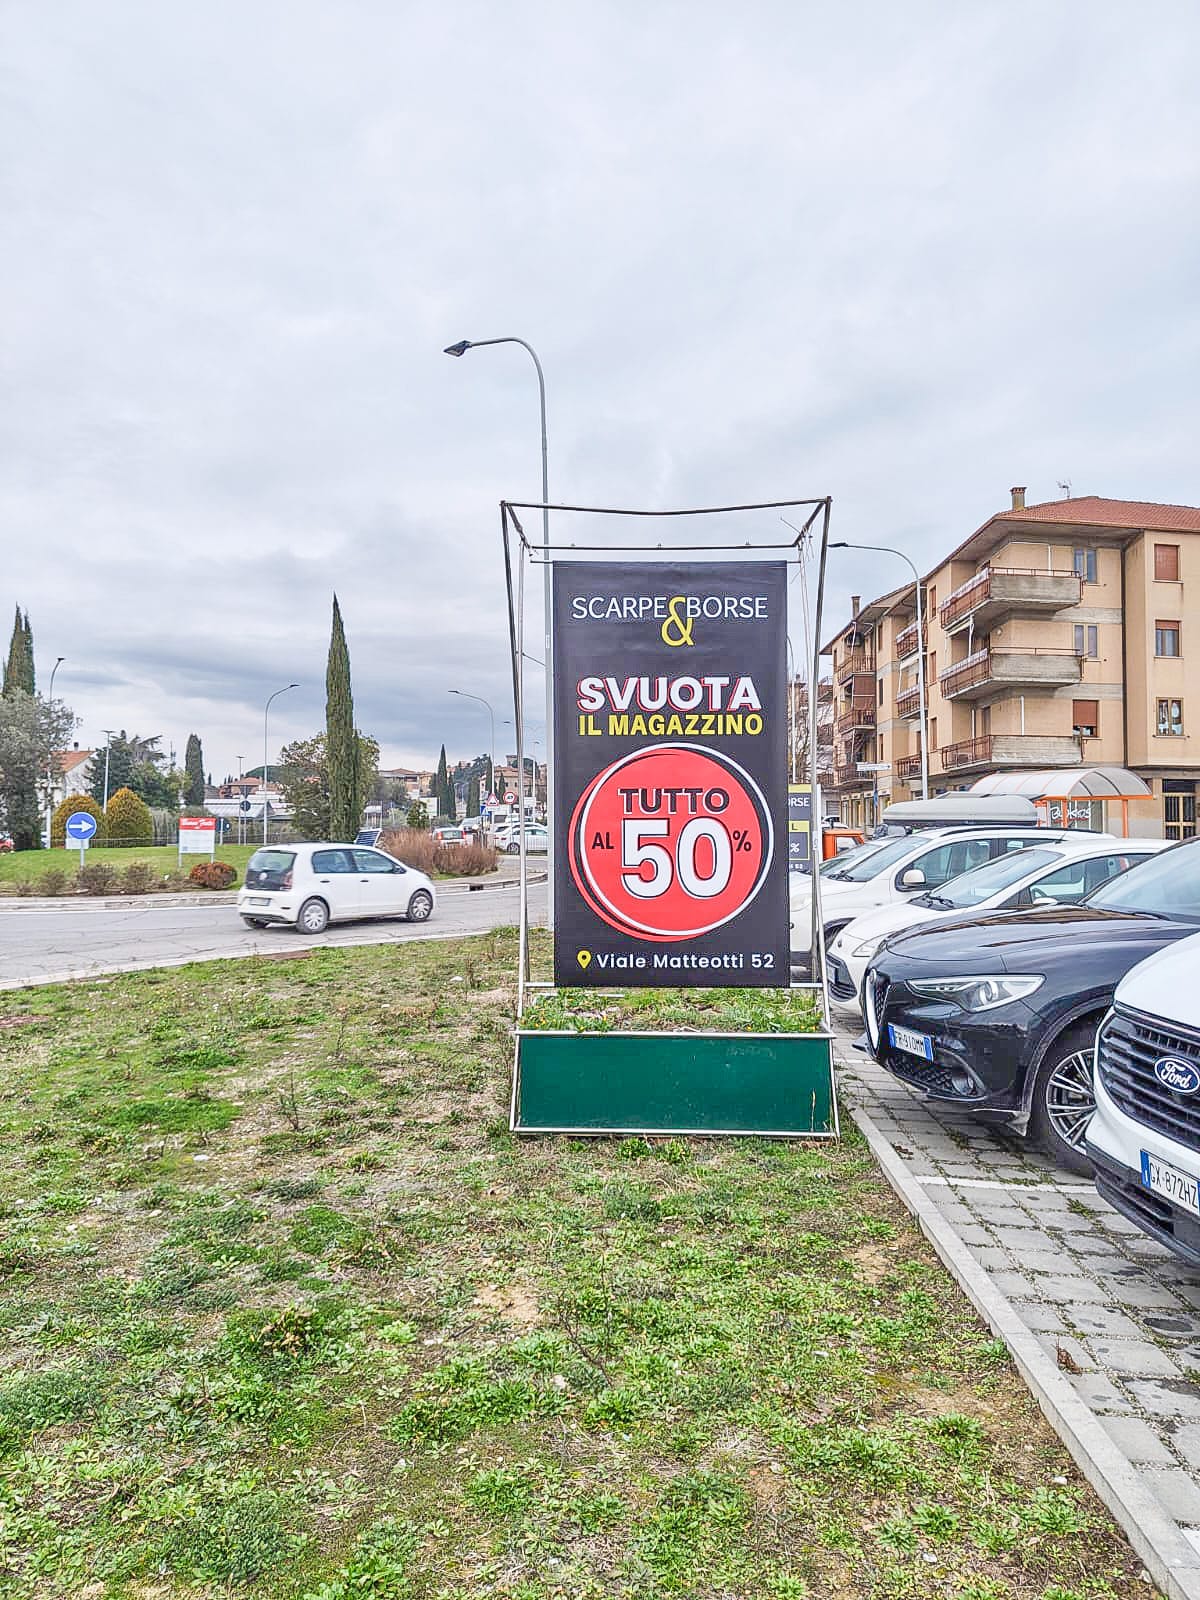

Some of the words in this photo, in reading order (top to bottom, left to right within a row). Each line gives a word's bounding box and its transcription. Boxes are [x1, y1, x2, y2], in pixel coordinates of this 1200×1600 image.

[577, 677, 762, 712] SVUOTA
[579, 715, 602, 735] IL
[609, 714, 763, 735] MAGAZZINO
[618, 788, 730, 815] TUTTO
[592, 832, 614, 849] AL
[597, 954, 646, 968] Viale
[653, 954, 744, 968] Matteotti
[752, 954, 775, 968] 52
[1160, 1061, 1191, 1089] Ford
